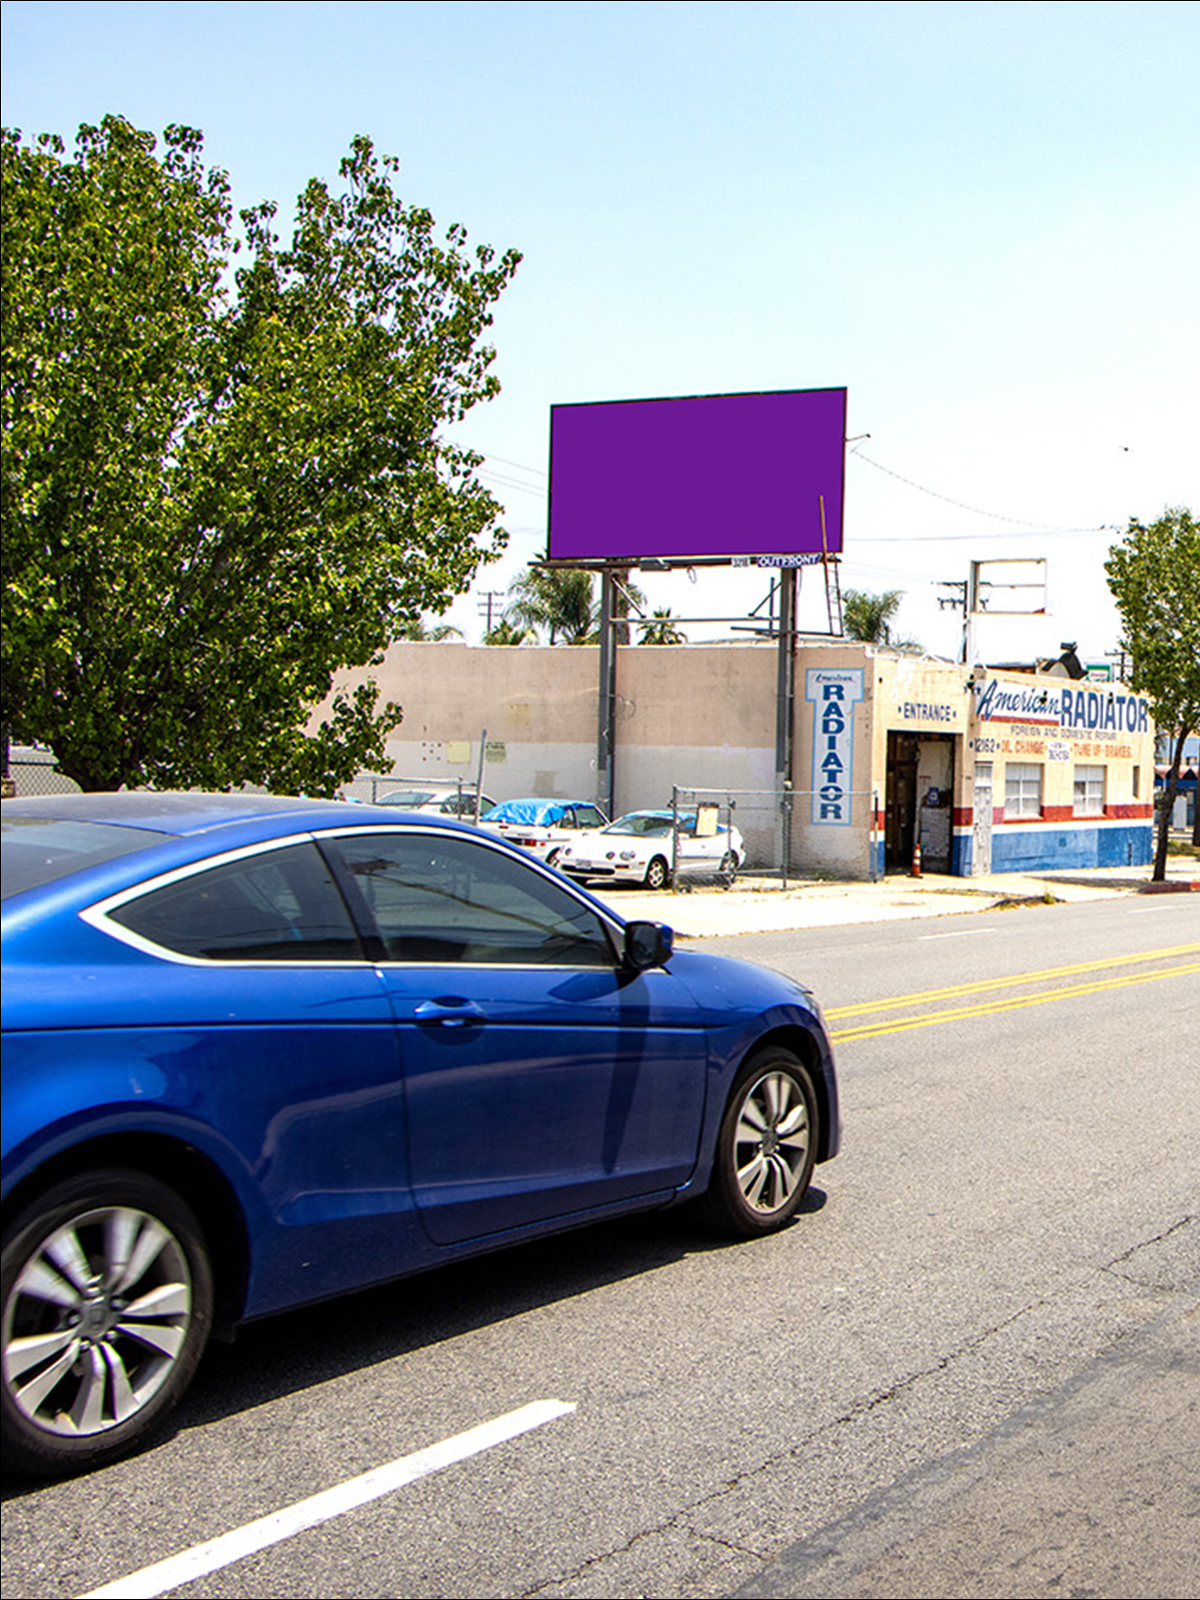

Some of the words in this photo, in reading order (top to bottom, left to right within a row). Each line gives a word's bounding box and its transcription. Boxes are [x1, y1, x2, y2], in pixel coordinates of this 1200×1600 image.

[759, 553, 820, 568] OUTFRONT
[903, 701, 952, 721] ENTRANCE
[976, 678, 1062, 721] American
[1060, 688, 1149, 732] RADIATOR
[1011, 725, 1041, 736] FOREIGN
[1044, 727, 1058, 738] AND
[1061, 728, 1093, 740] DOMESTIC
[819, 684, 846, 819] RADIATOR
[1015, 740, 1045, 755] CHANGE
[1073, 742, 1091, 757] TUNE
